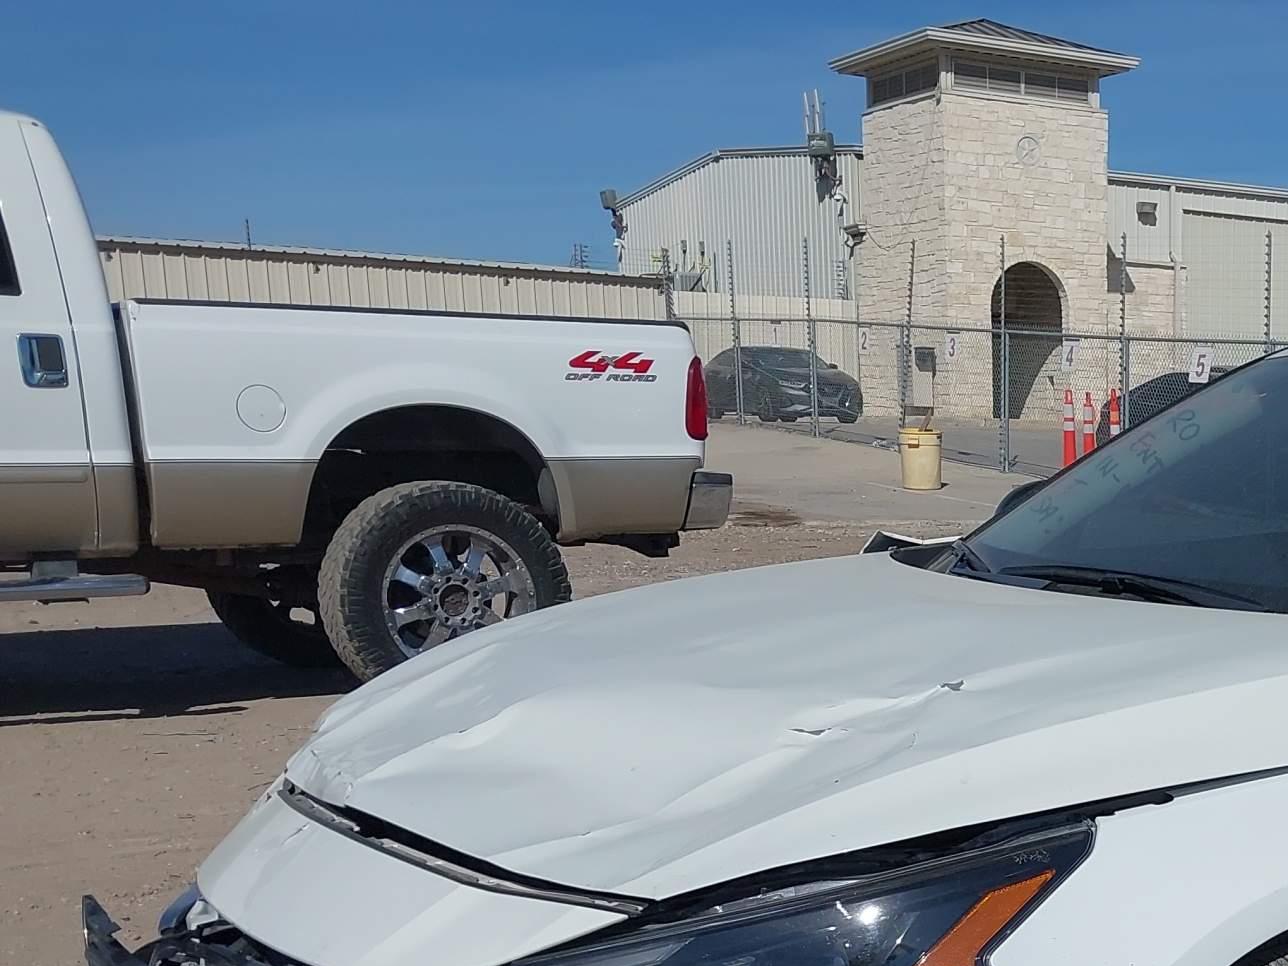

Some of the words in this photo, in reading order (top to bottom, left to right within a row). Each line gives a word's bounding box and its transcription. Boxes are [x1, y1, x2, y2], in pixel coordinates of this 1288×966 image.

[860, 331, 868, 350] 2
[948, 337, 956, 357] 3
[1065, 345, 1075, 367] 4
[1195, 353, 1207, 378] 5
[564, 372, 603, 382] OFF
[605, 373, 658, 383] ROAD
